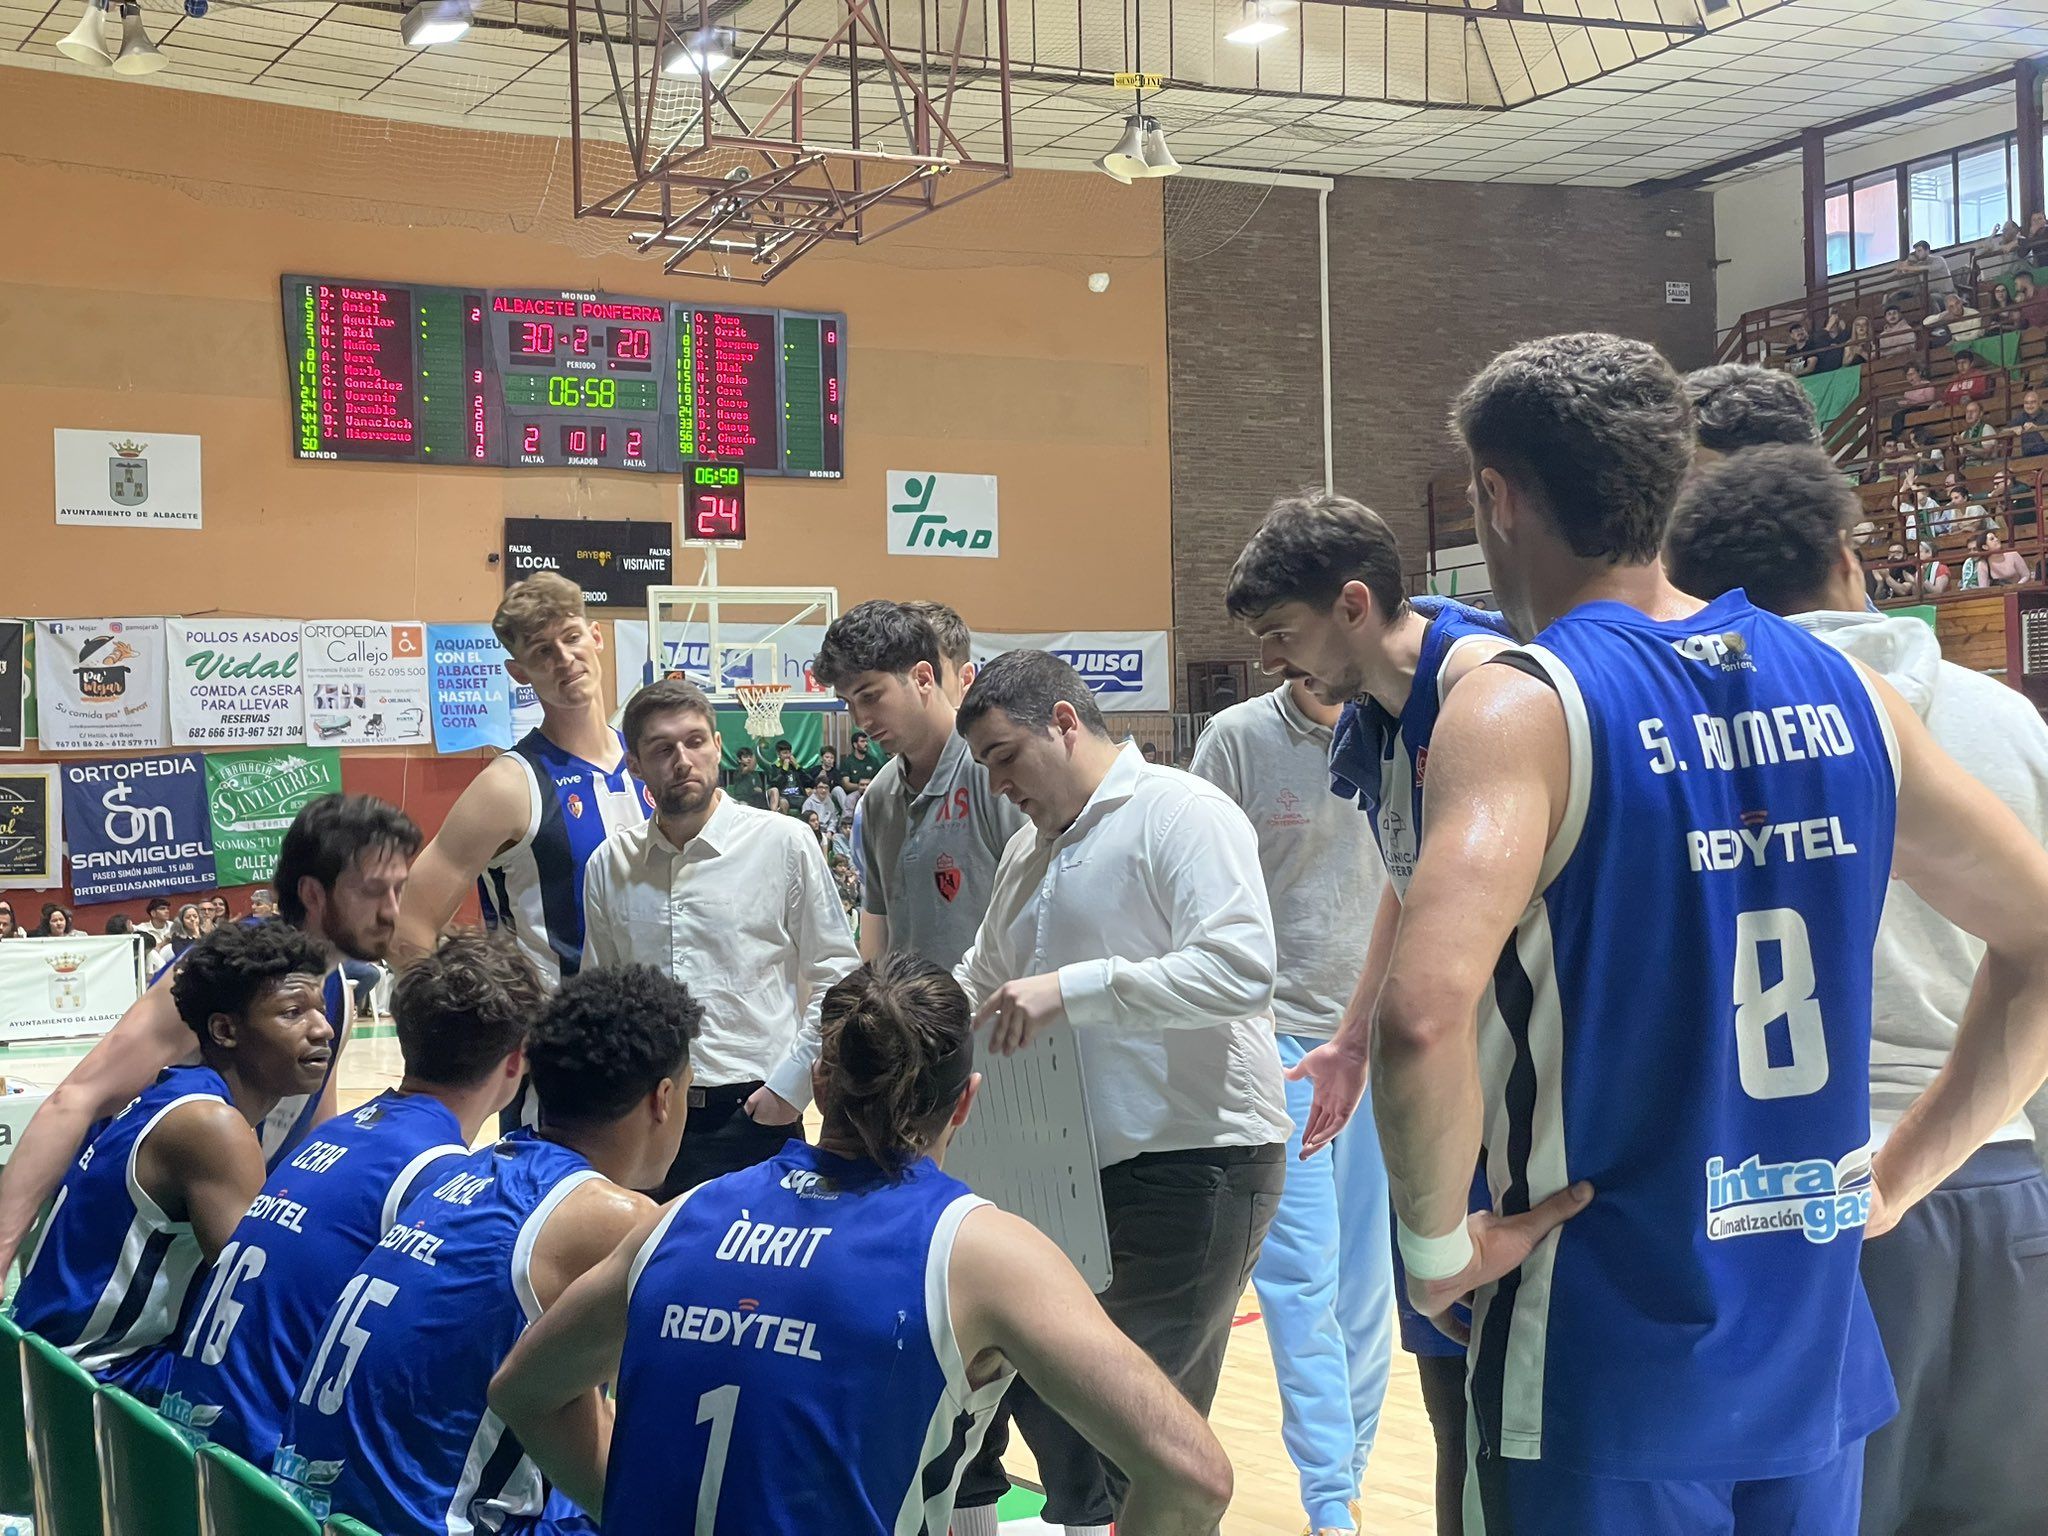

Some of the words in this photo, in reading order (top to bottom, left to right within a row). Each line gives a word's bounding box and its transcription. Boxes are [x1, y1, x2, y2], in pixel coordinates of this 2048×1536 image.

[341, 288, 387, 302] Varela
[561, 292, 596, 301] MONDO
[493, 297, 576, 316] ALBACETE
[582, 303, 662, 322] PONFERRA
[522, 322, 554, 353] 30
[573, 328, 588, 353] 2
[617, 329, 649, 359] 20
[566, 360, 596, 370] PERIODO
[344, 378, 403, 391] González
[549, 376, 615, 408] 06:58
[524, 427, 539, 452] 2
[626, 431, 641, 456] 2
[300, 450, 338, 459] MONDO
[520, 455, 545, 464] FALTAS
[567, 457, 598, 466] JUGADOR
[623, 459, 646, 467] FALTAS
[695, 467, 738, 485] 06:58
[809, 470, 841, 479] MONDO
[60, 508, 132, 517] AYUNTAMIENTO
[153, 512, 199, 520] ALBACETE
[698, 496, 738, 533] 24
[508, 545, 532, 553] FALTAS
[649, 548, 671, 557] FALTAS
[516, 556, 560, 569] LOCAL
[623, 558, 666, 572] VISITANTE
[581, 591, 607, 602] ERIODO
[186, 631, 238, 643] POLLOS
[242, 631, 299, 643] ASADOS
[304, 625, 388, 638] ORTOPEDIA
[434, 638, 505, 651] AQUADEU
[327, 640, 388, 666] Callejo
[434, 652, 465, 664] CON
[467, 652, 483, 663] EL
[185, 650, 299, 681] Vidal
[368, 668, 386, 677] 652
[387, 668, 406, 677] 095
[407, 667, 426, 677] 500
[437, 664, 502, 676] ALBACETE
[190, 685, 247, 697] COMIDA
[250, 684, 303, 697] CASERA
[437, 678, 488, 689] BASKET
[439, 691, 484, 702] HASTA
[486, 690, 503, 702] LA
[55, 702, 67, 714] Su
[68, 710, 103, 719] comida
[201, 700, 236, 711] PARA
[240, 699, 289, 711] LLEVAR
[440, 702, 488, 715] ÚLTIMA
[220, 714, 271, 724] RESERVAS
[442, 717, 477, 728] GOTA
[188, 727, 206, 738] 682
[208, 727, 225, 738] 666
[267, 726, 283, 738] 521
[286, 726, 303, 737] 304
[1638, 717, 1688, 775] S.
[1692, 703, 1855, 772] ROMERO
[69, 757, 196, 783] ORTOPEDIA
[220, 763, 272, 779] FARMACIA
[271, 764, 330, 798] TERESA
[556, 774, 582, 787] vive
[215, 838, 257, 850] SOMOS
[1686, 816, 1858, 873] REDYTEL
[71, 841, 214, 870] SANMIGUEL
[235, 855, 267, 870] CALLE
[93, 870, 117, 881] PASEO
[118, 867, 141, 878] SIMÓN
[169, 864, 177, 873] 15
[178, 862, 194, 873] (AB)
[1733, 907, 1830, 1101] 8
[9, 1017, 73, 1028] AYUNTAMIENTO
[291, 1140, 349, 1174] CERA
[1708, 1154, 1836, 1210] intra
[245, 1194, 309, 1234] EDYTEL
[1709, 1209, 1804, 1239] Climatización
[378, 1223, 445, 1267] EDYTEL
[715, 1209, 833, 1269] ÒRRIT
[181, 1241, 267, 1366] 16
[660, 1304, 822, 1361] REDYTEL
[299, 1273, 400, 1416] 15
[694, 1383, 741, 1536] 1
